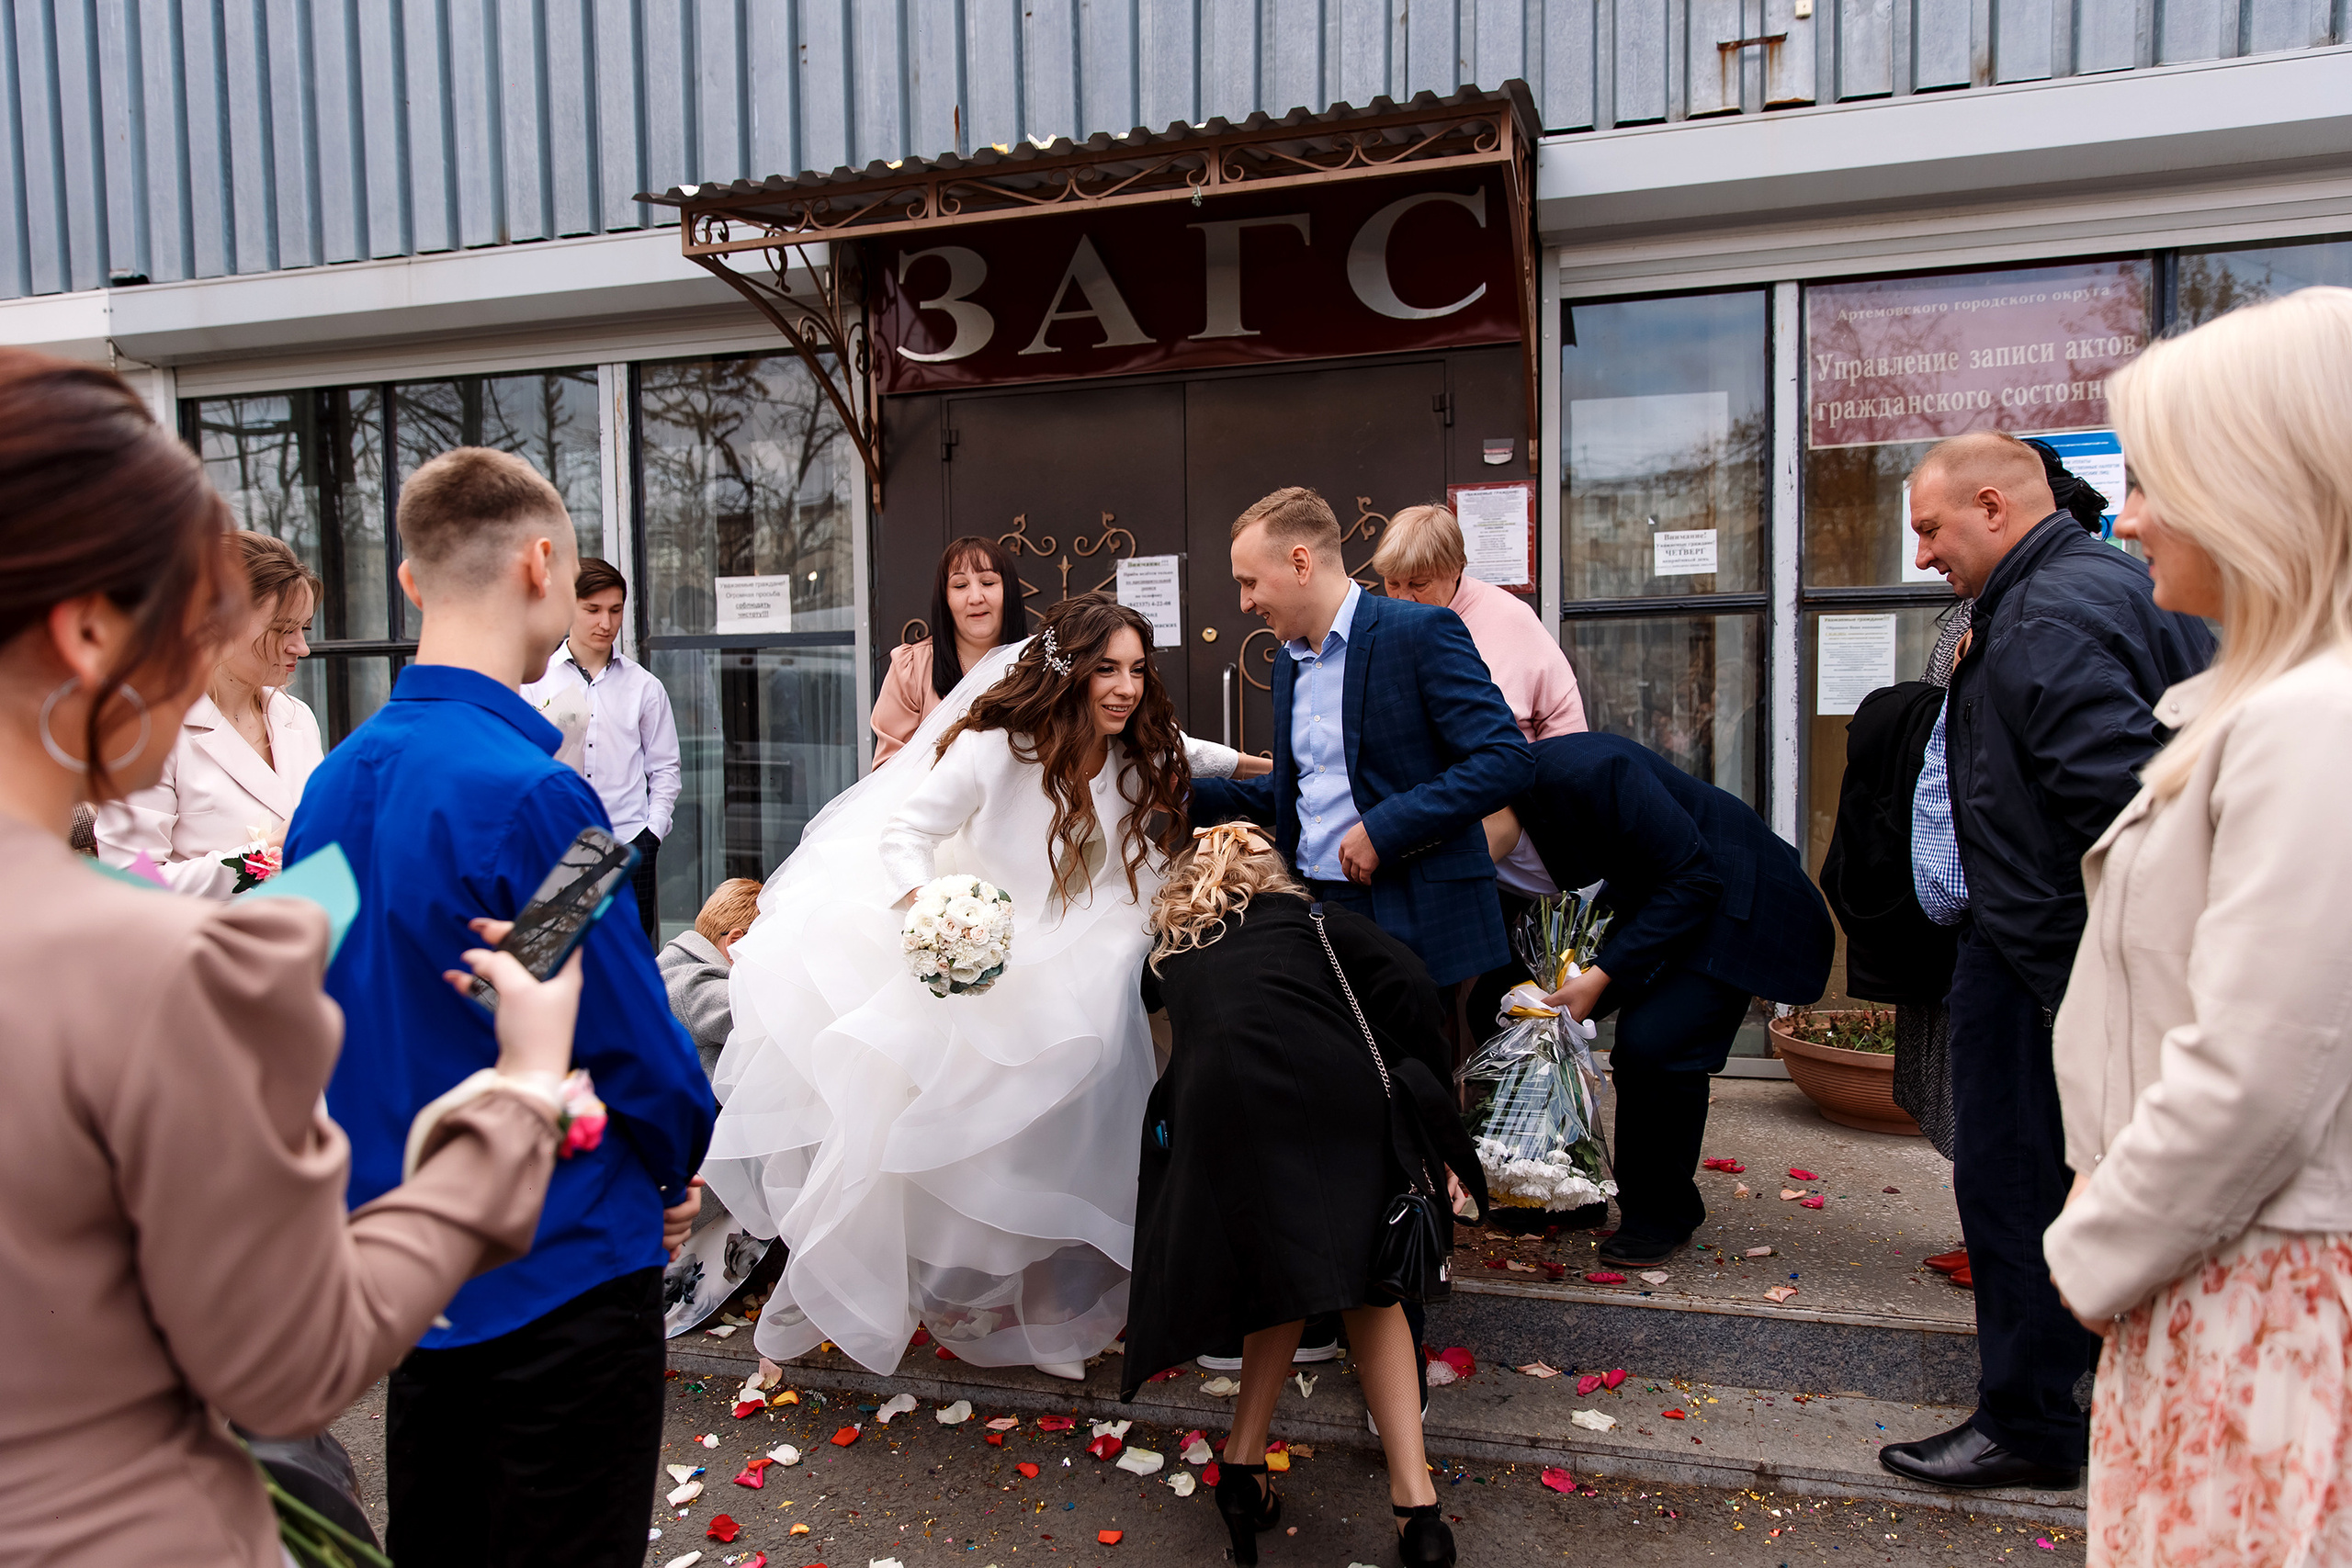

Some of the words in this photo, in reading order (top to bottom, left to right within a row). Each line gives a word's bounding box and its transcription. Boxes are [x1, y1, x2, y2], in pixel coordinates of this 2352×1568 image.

[896, 186, 1487, 363] ЗАГС
[1837, 300, 1948, 322] Артемовского
[1954, 294, 2047, 313] городского
[2052, 286, 2110, 304] округа
[1815, 351, 1960, 388] Управление
[1969, 342, 2055, 369] записи
[2064, 334, 2137, 361] актов
[1816, 389, 1991, 429] гражданского
[2000, 379, 2109, 408] состоян
[1664, 532, 1707, 541] Внимание!
[1665, 547, 1706, 557] ЧЕТВЕРГ
[735, 602, 772, 610] соблюдать
[755, 590, 781, 599] просьба
